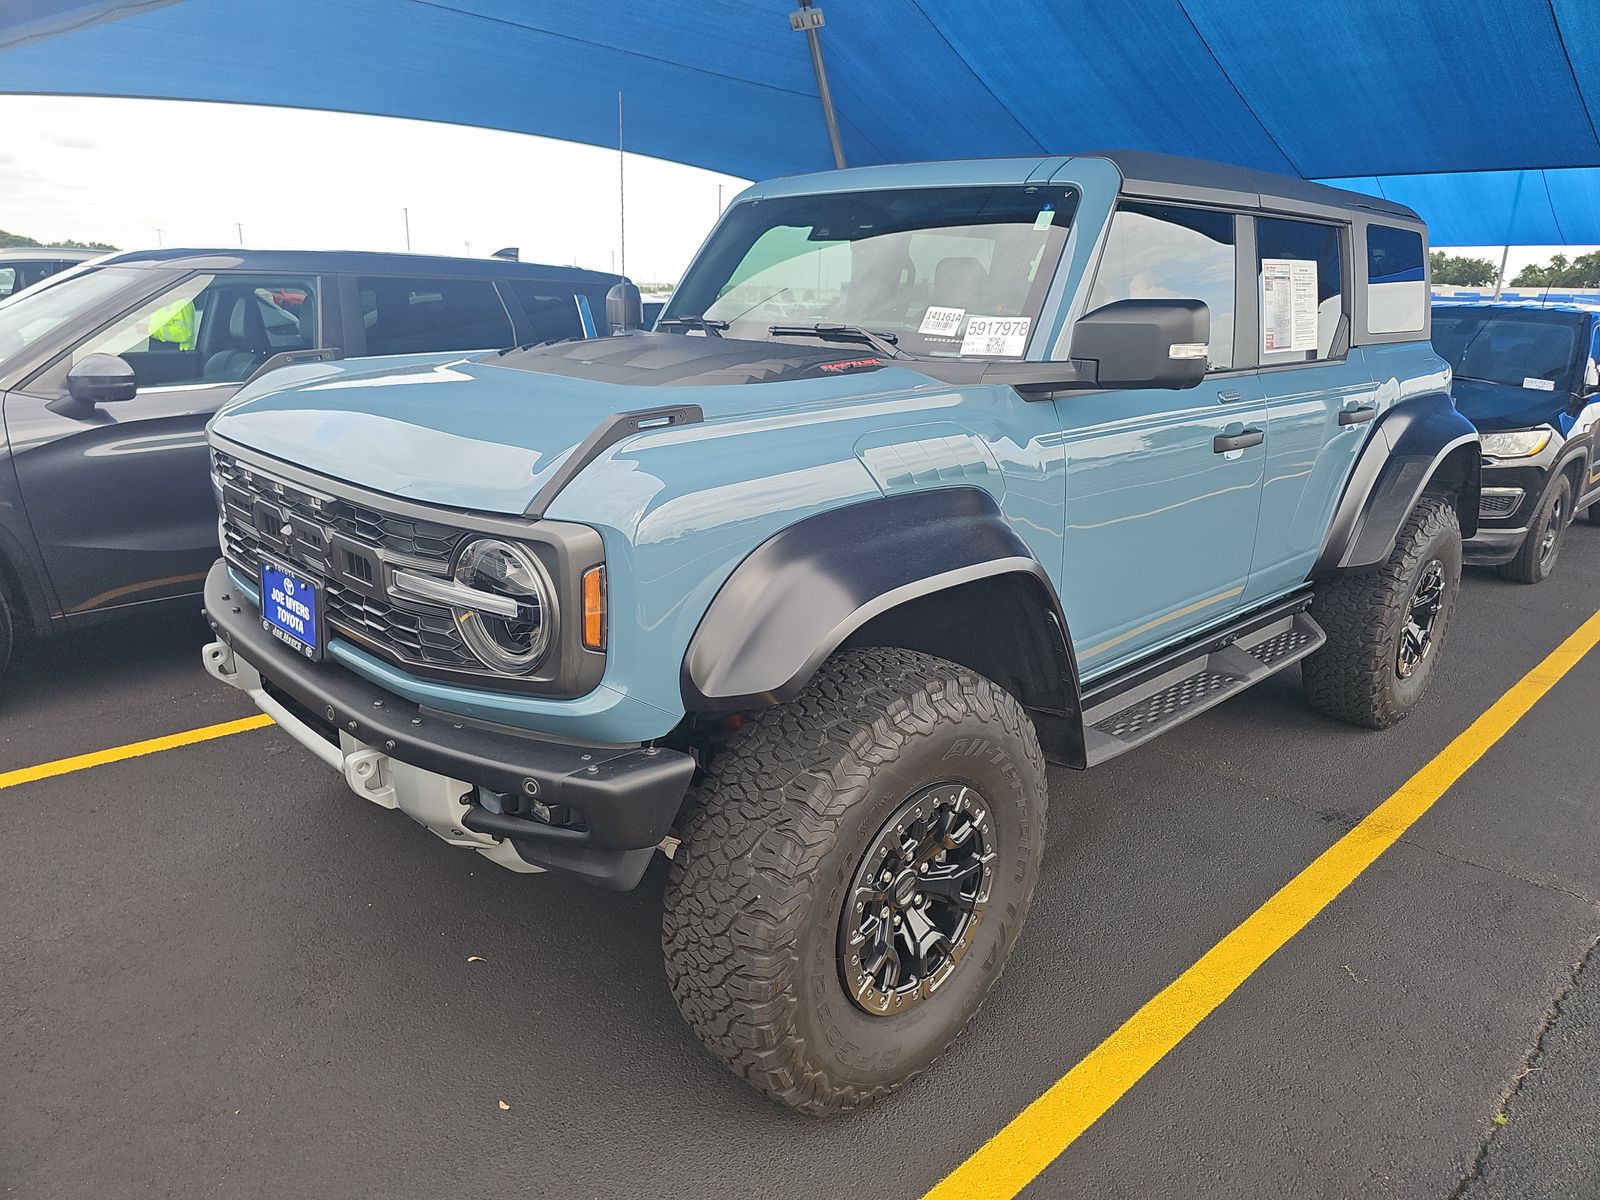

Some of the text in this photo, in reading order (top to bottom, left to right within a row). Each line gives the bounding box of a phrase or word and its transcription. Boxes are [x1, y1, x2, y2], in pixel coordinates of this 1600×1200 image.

[926, 310, 962, 323] 141161A
[968, 321, 1029, 337] 5917978
[271, 587, 311, 621] JOE MYERS
[276, 606, 305, 635] TOYOTA
